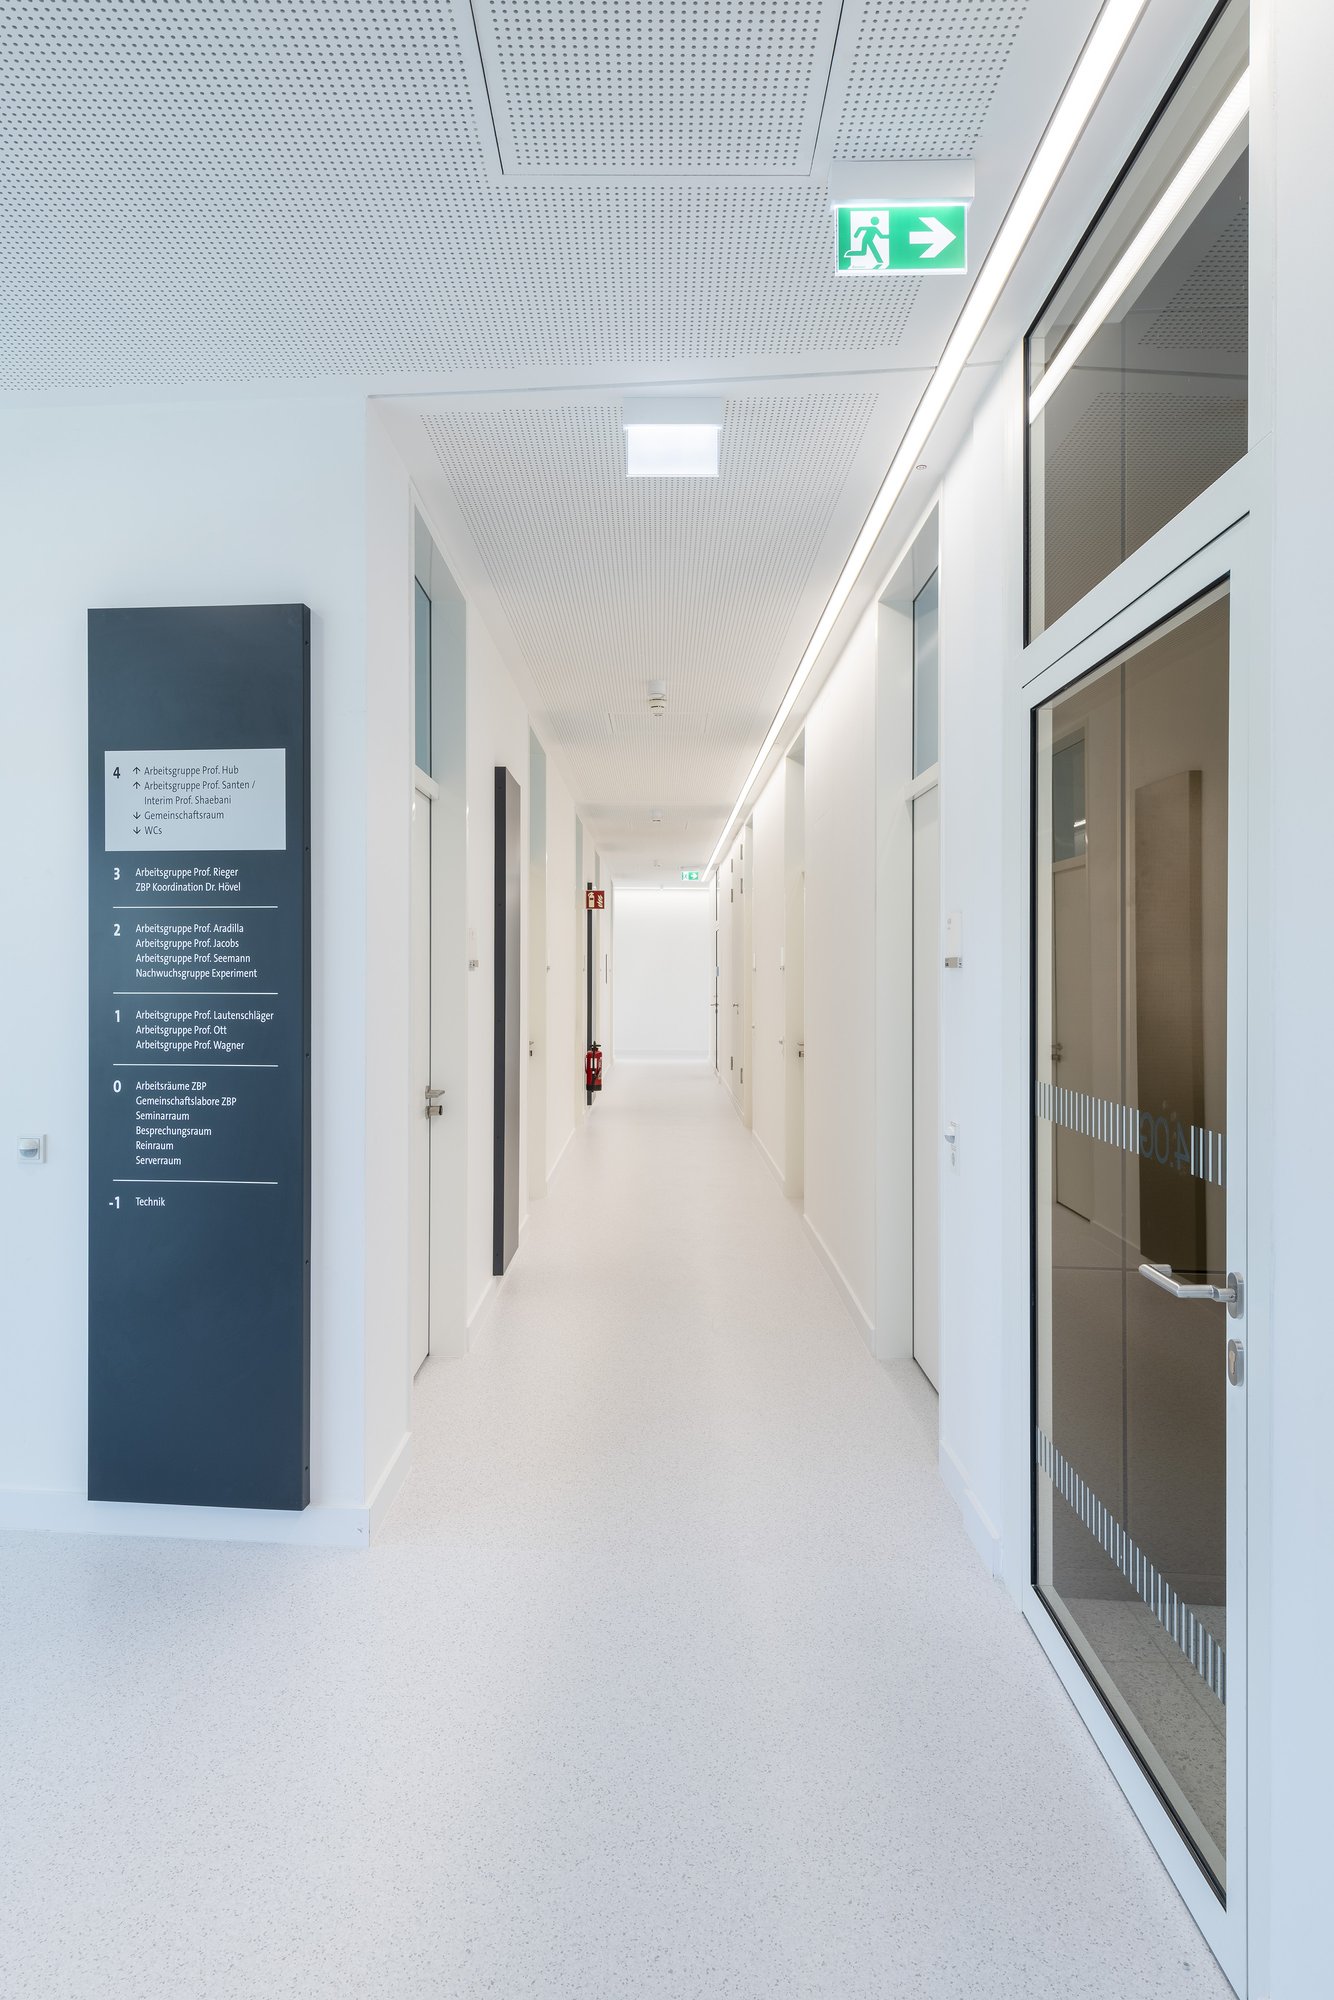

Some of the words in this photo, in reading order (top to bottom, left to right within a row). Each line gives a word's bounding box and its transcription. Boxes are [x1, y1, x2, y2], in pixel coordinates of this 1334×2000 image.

[112, 766, 121, 780] 4
[144, 765, 201, 778] Arbeitsgruppe
[202, 765, 220, 775] Prof.
[222, 765, 239, 775] Hub
[144, 780, 201, 793] Arbeitsgruppe
[202, 780, 220, 790] Prof.
[222, 780, 250, 790] Santen
[144, 795, 174, 806] Interim
[175, 795, 193, 805] Prof.
[195, 795, 232, 805] Shaebani
[144, 810, 225, 820] Gemeinschaftsraum
[144, 825, 163, 835] WCs
[113, 867, 121, 880] 3
[135, 867, 193, 879] Arbeitsgruppe
[194, 867, 212, 877] Prof.
[213, 867, 239, 879] Rieger
[135, 882, 151, 892] ZBP
[152, 882, 204, 892] Koordination
[205, 882, 217, 892] Dr.
[218, 882, 241, 892] Hövel
[113, 923, 121, 936] 2
[135, 922, 193, 935] Arbeitsgruppe
[194, 922, 212, 933] Prof.
[213, 923, 245, 933] Aradilla
[135, 937, 193, 950] Arbeitsgruppe
[194, 937, 212, 948] Prof.
[213, 938, 240, 948] Jacobs
[135, 952, 193, 965] Arbeitsgruppe
[194, 952, 212, 963] Prof.
[213, 953, 251, 963] Seemann
[135, 967, 211, 980] Nachwuchsgruppe
[211, 967, 258, 980] Experiment
[114, 1009, 121, 1022] 1
[135, 1009, 193, 1022] Arbeitsgruppe
[194, 1009, 212, 1020] Prof.
[213, 1009, 275, 1023] Lautenschläger
[135, 1024, 193, 1037] Arbeitsgruppe
[194, 1024, 212, 1035] Prof.
[213, 1025, 228, 1035] Ott
[135, 1039, 193, 1052] Arbeitsgruppe
[194, 1039, 212, 1050] Prof.
[213, 1040, 246, 1053] Wagner
[113, 1080, 122, 1093] 0
[135, 1080, 190, 1091] Arbeitsräume
[191, 1081, 207, 1091] ZBP
[135, 1095, 220, 1106] Gemeinschaftslabore
[221, 1096, 237, 1106] ZBP
[135, 1110, 190, 1121] Seminarraum
[135, 1125, 212, 1138] Besprechungsraum
[135, 1140, 174, 1151] Reinraum
[135, 1155, 182, 1166] Serverraum
[109, 1196, 121, 1209] -1
[135, 1196, 166, 1207] Technik
